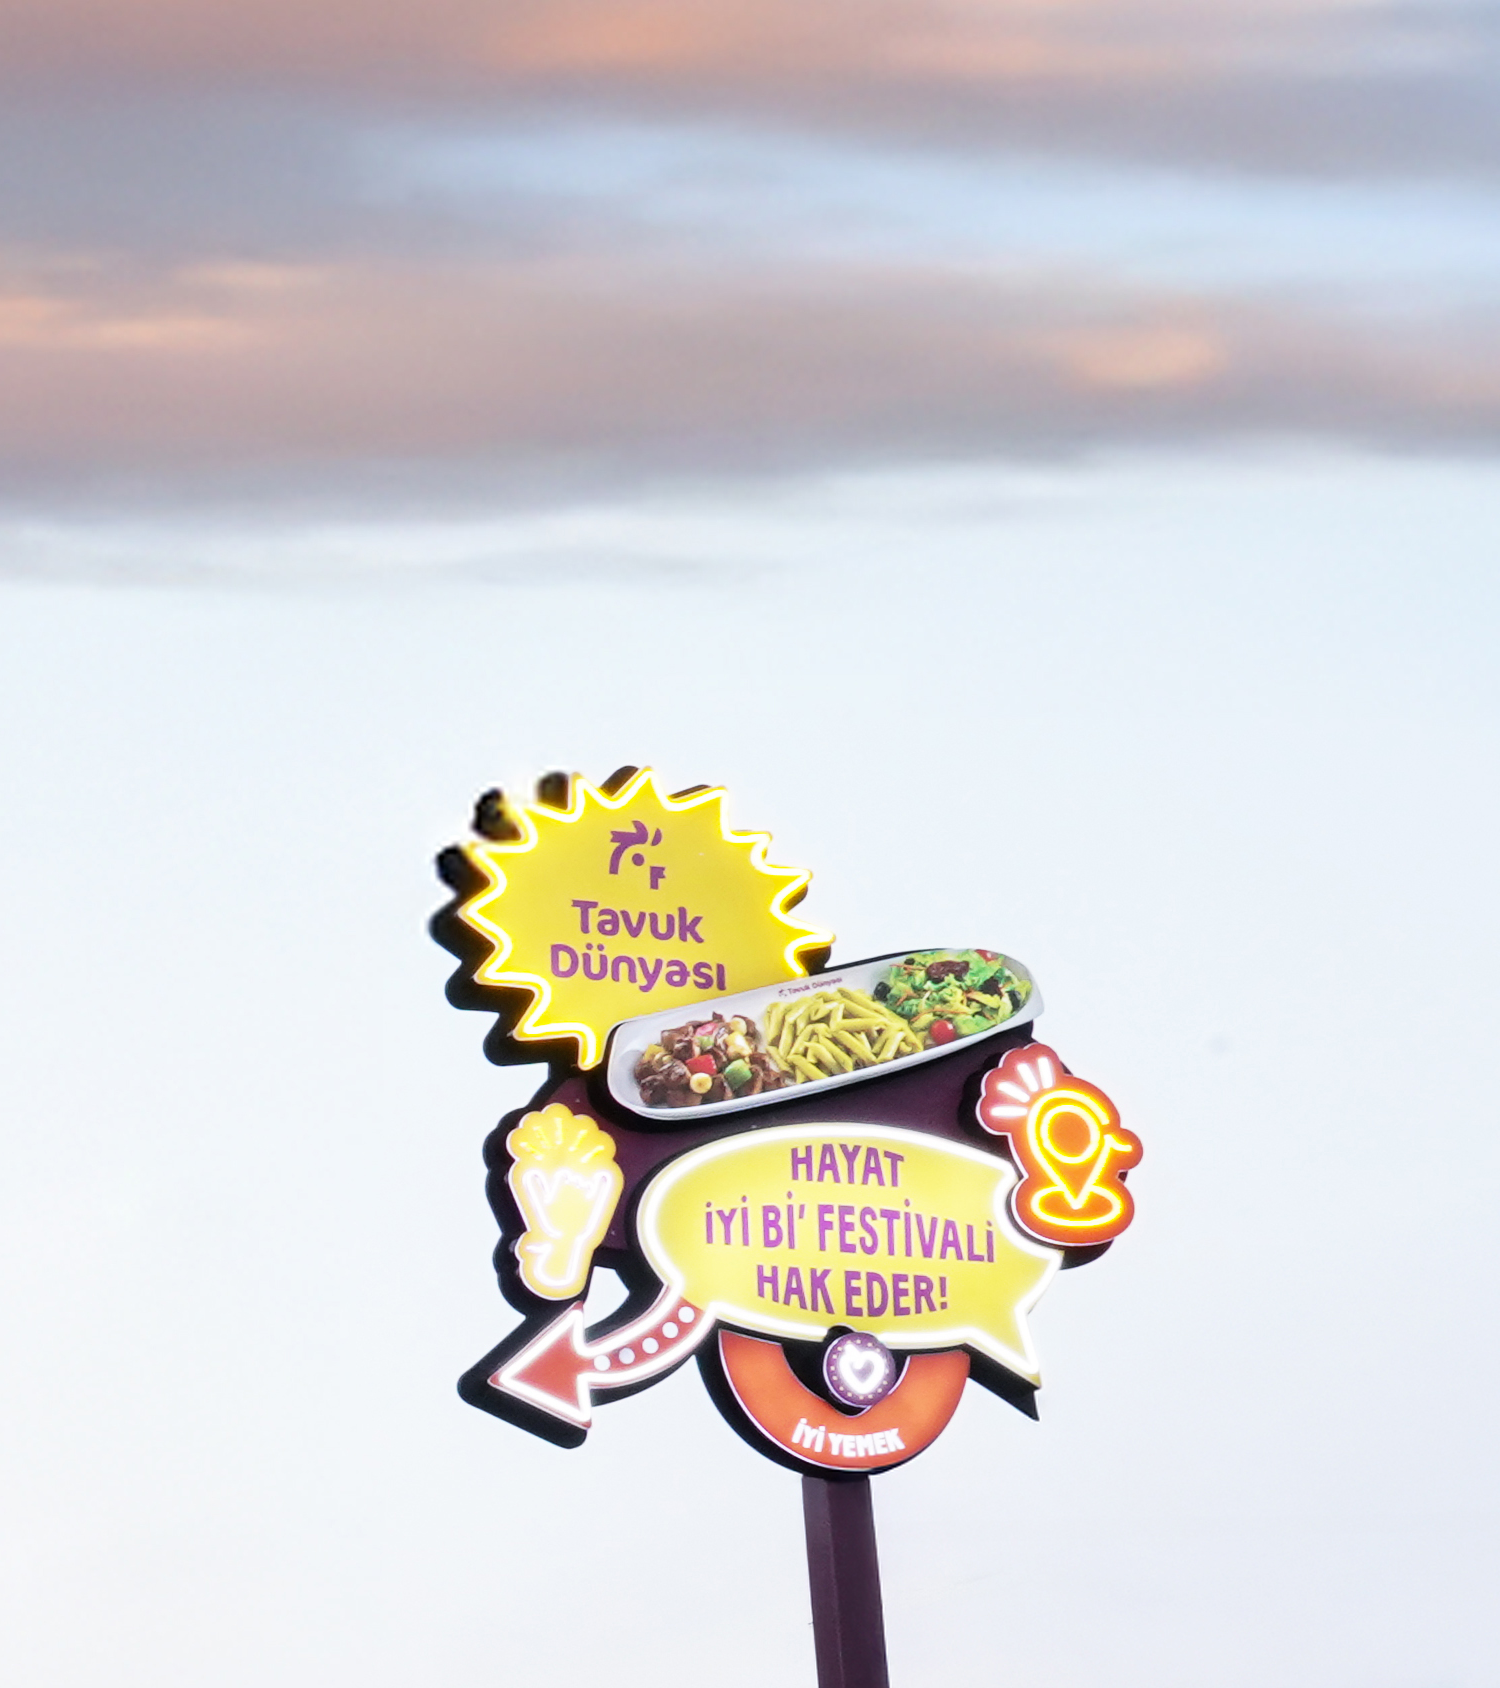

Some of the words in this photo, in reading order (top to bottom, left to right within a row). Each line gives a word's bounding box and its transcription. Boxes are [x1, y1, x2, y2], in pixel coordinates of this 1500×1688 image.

[571, 900, 705, 945] Tavuk
[550, 942, 727, 993] Dünyası
[790, 1143, 904, 1188] HAYAT
[704, 1195, 750, 1246] İYİ
[817, 1198, 996, 1264] FESTİVALİ
[756, 1264, 832, 1315] HAK
[845, 1274, 949, 1318] EDER!
[791, 1417, 826, 1453] İYİ
[828, 1428, 906, 1458] YEMEK
